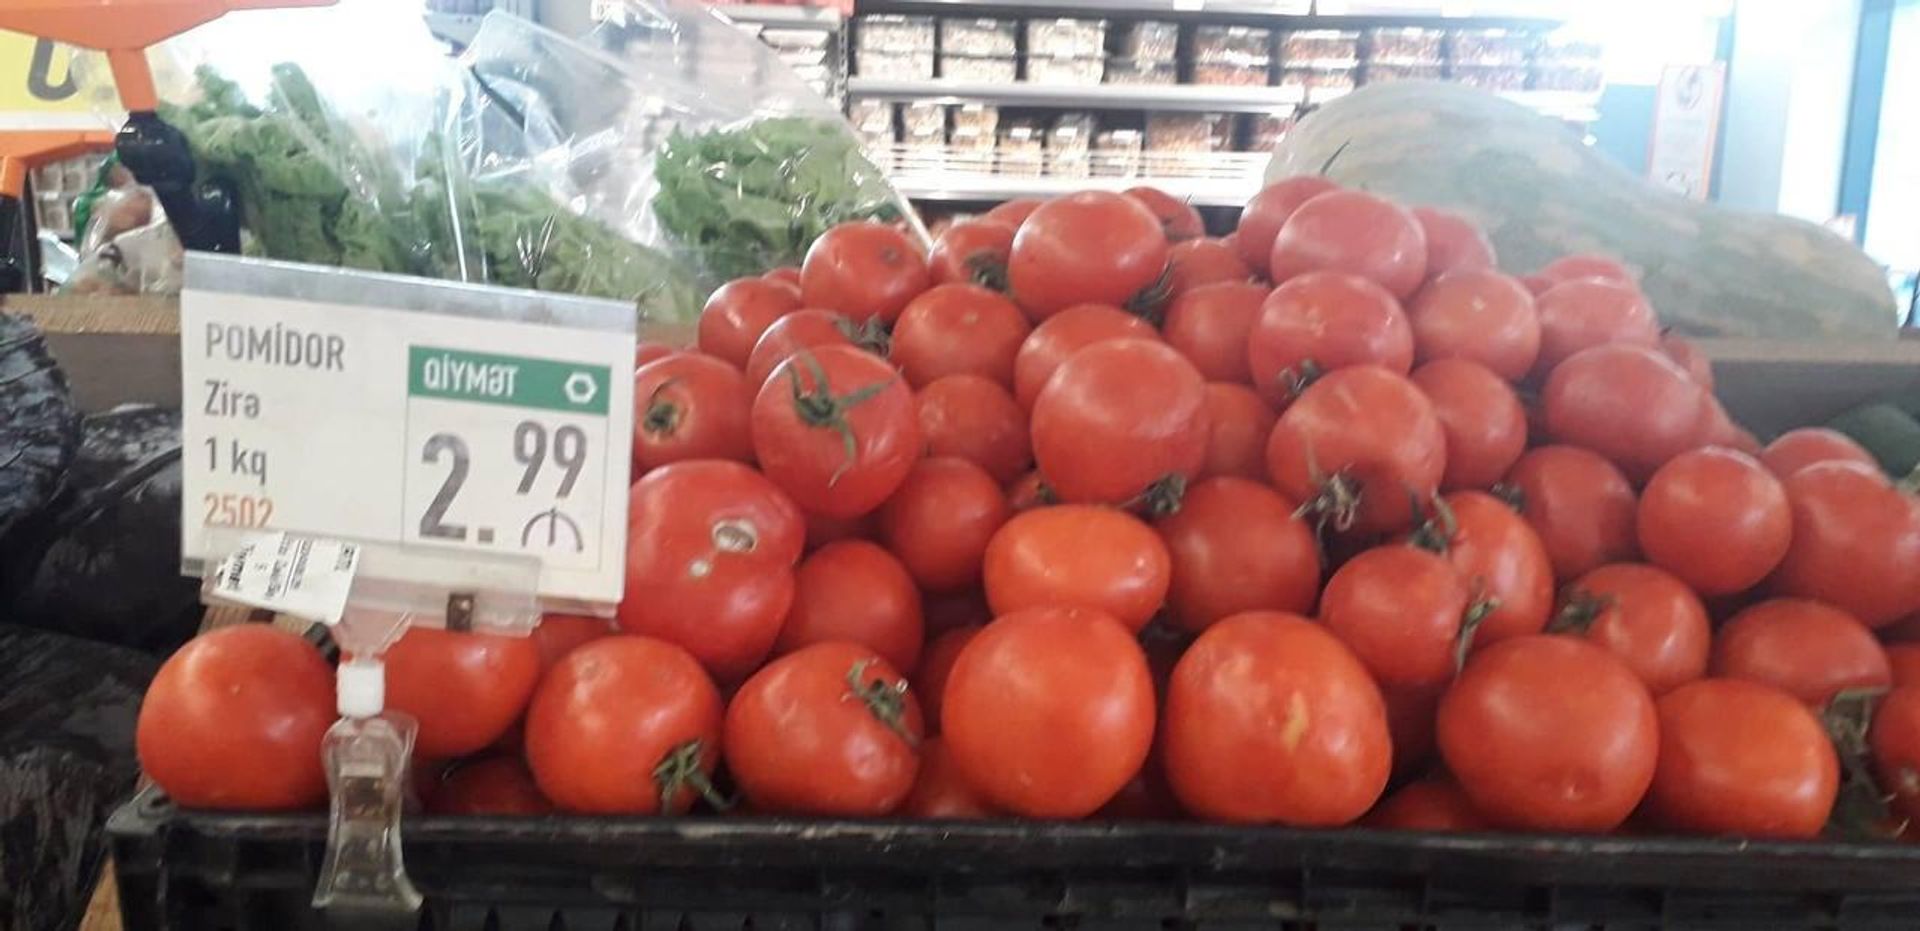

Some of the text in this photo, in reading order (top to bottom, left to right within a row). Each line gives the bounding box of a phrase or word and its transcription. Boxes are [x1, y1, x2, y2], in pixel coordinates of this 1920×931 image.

[205, 322, 345, 371] POMİDOR
[423, 354, 519, 398] QİYMƏT
[204, 379, 261, 419] Zirə
[204, 436, 267, 486] 1 kq
[204, 491, 275, 529] 2502
